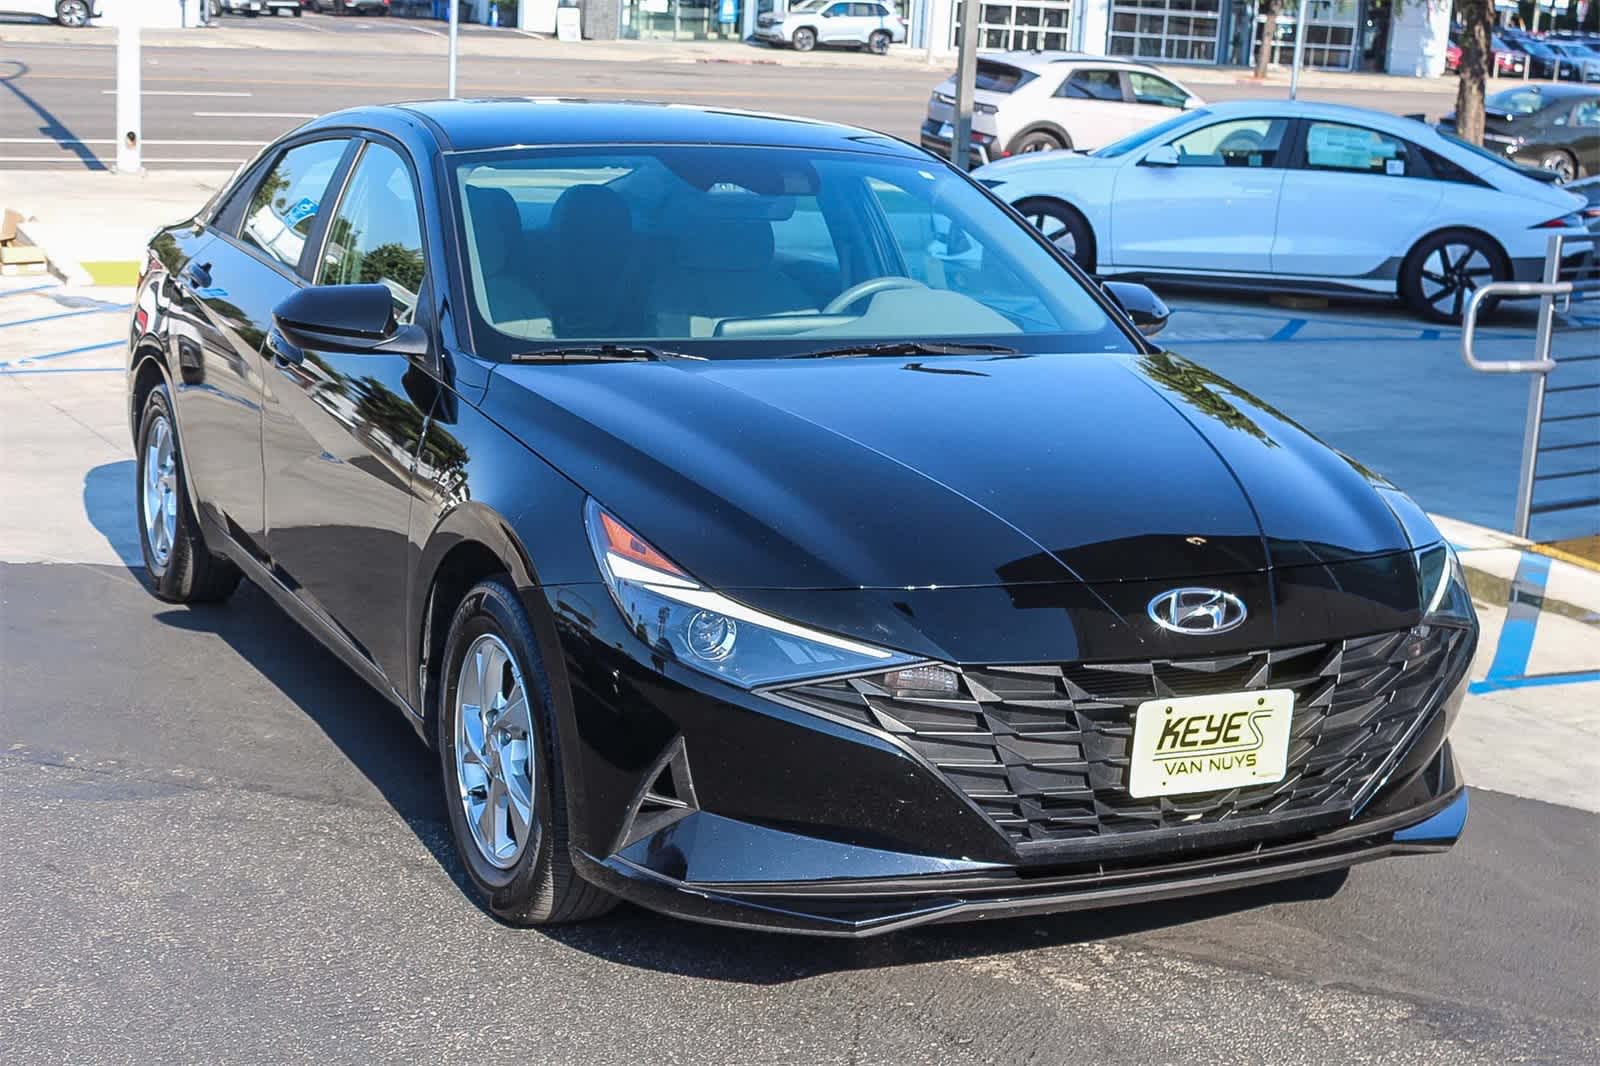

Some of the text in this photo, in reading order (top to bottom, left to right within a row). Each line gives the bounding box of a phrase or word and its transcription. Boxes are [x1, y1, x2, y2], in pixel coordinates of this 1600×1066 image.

[1156, 709, 1274, 751] KEYES
[1164, 753, 1257, 776] VAN NUYS
